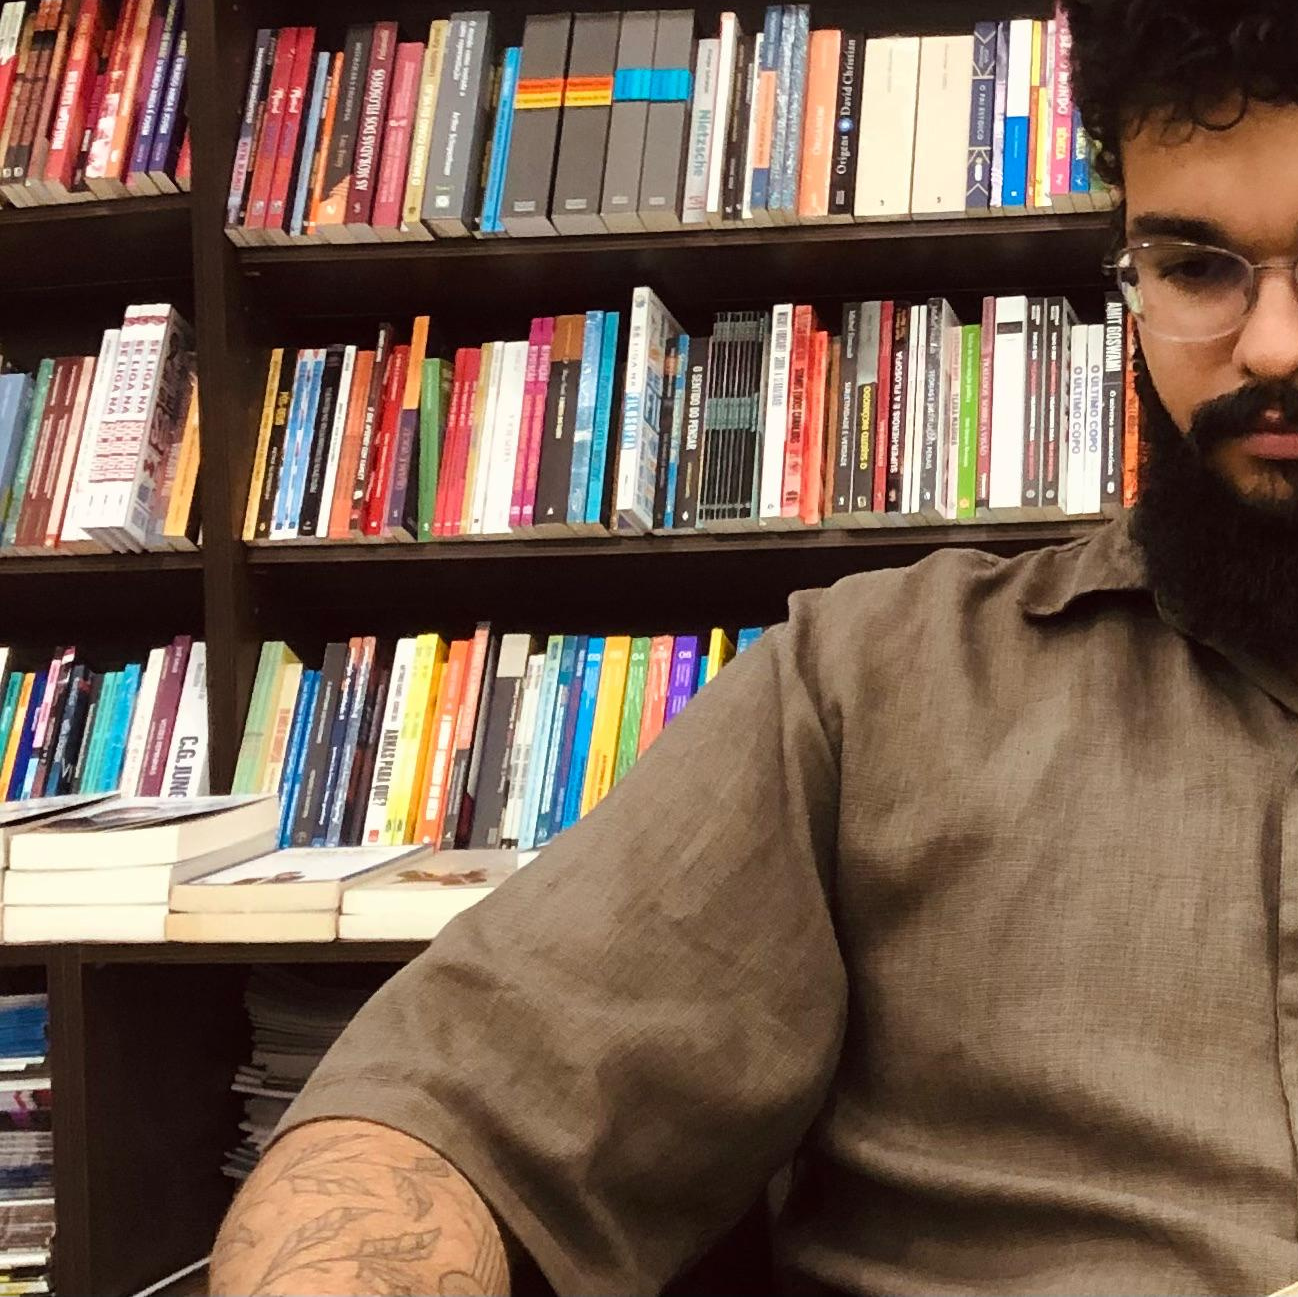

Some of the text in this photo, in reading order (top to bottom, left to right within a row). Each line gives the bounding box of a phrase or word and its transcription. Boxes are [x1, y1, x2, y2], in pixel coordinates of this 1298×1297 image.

[842, 39, 856, 84] Christian
[364, 69, 386, 115] FILÓSOFOS
[841, 87, 853, 116] David
[694, 110, 711, 176] Nietzsche
[1105, 302, 1122, 372] AMIT GOSWAMI
[1074, 366, 1083, 374] O
[1091, 365, 1100, 373] O
[1072, 421, 1081, 454] COPO
[1089, 420, 1098, 452] COPO
[174, 736, 198, 763] C.G.
[381, 729, 399, 758] ARMAS
[376, 761, 393, 782] PARA
